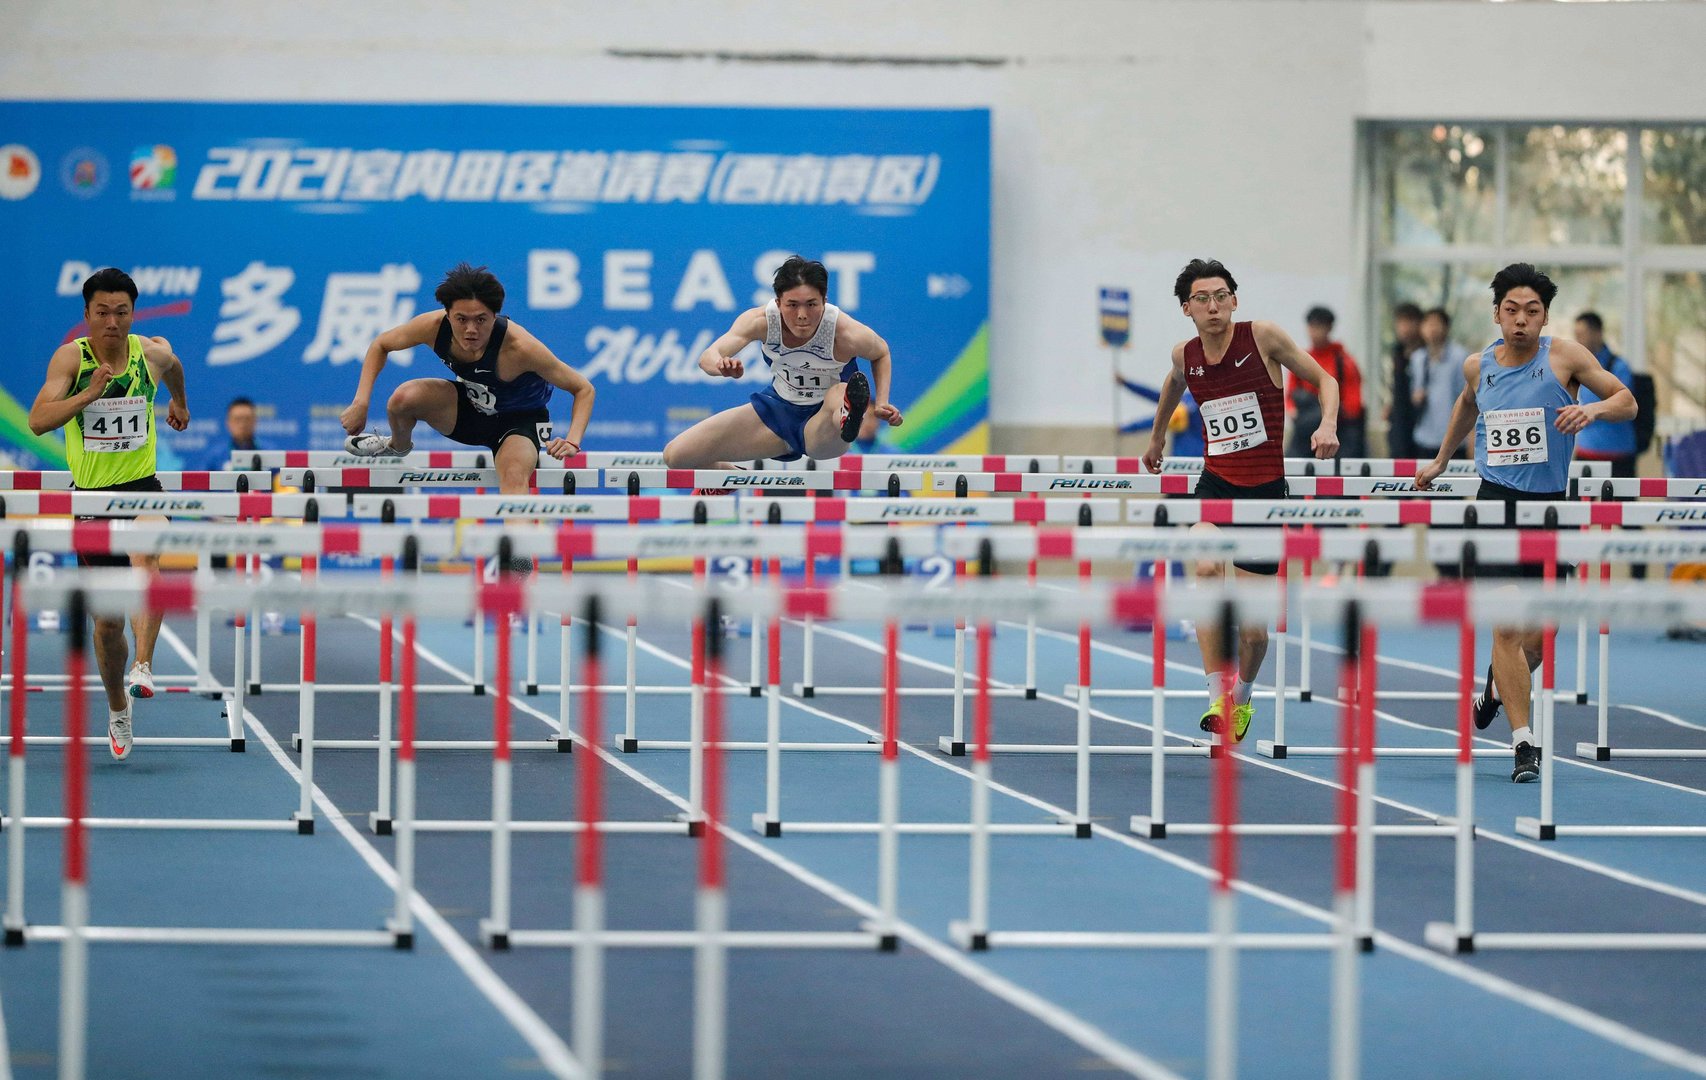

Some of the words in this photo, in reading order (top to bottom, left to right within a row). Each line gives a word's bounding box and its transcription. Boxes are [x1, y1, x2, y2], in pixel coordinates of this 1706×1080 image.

[206, 260, 422, 367] 多威
[1189, 365, 1205, 376] 上海
[92, 414, 139, 435] 411
[1209, 411, 1258, 437] 505
[1491, 426, 1542, 448] 386
[718, 556, 750, 592] 3
[919, 556, 955, 591] 2
